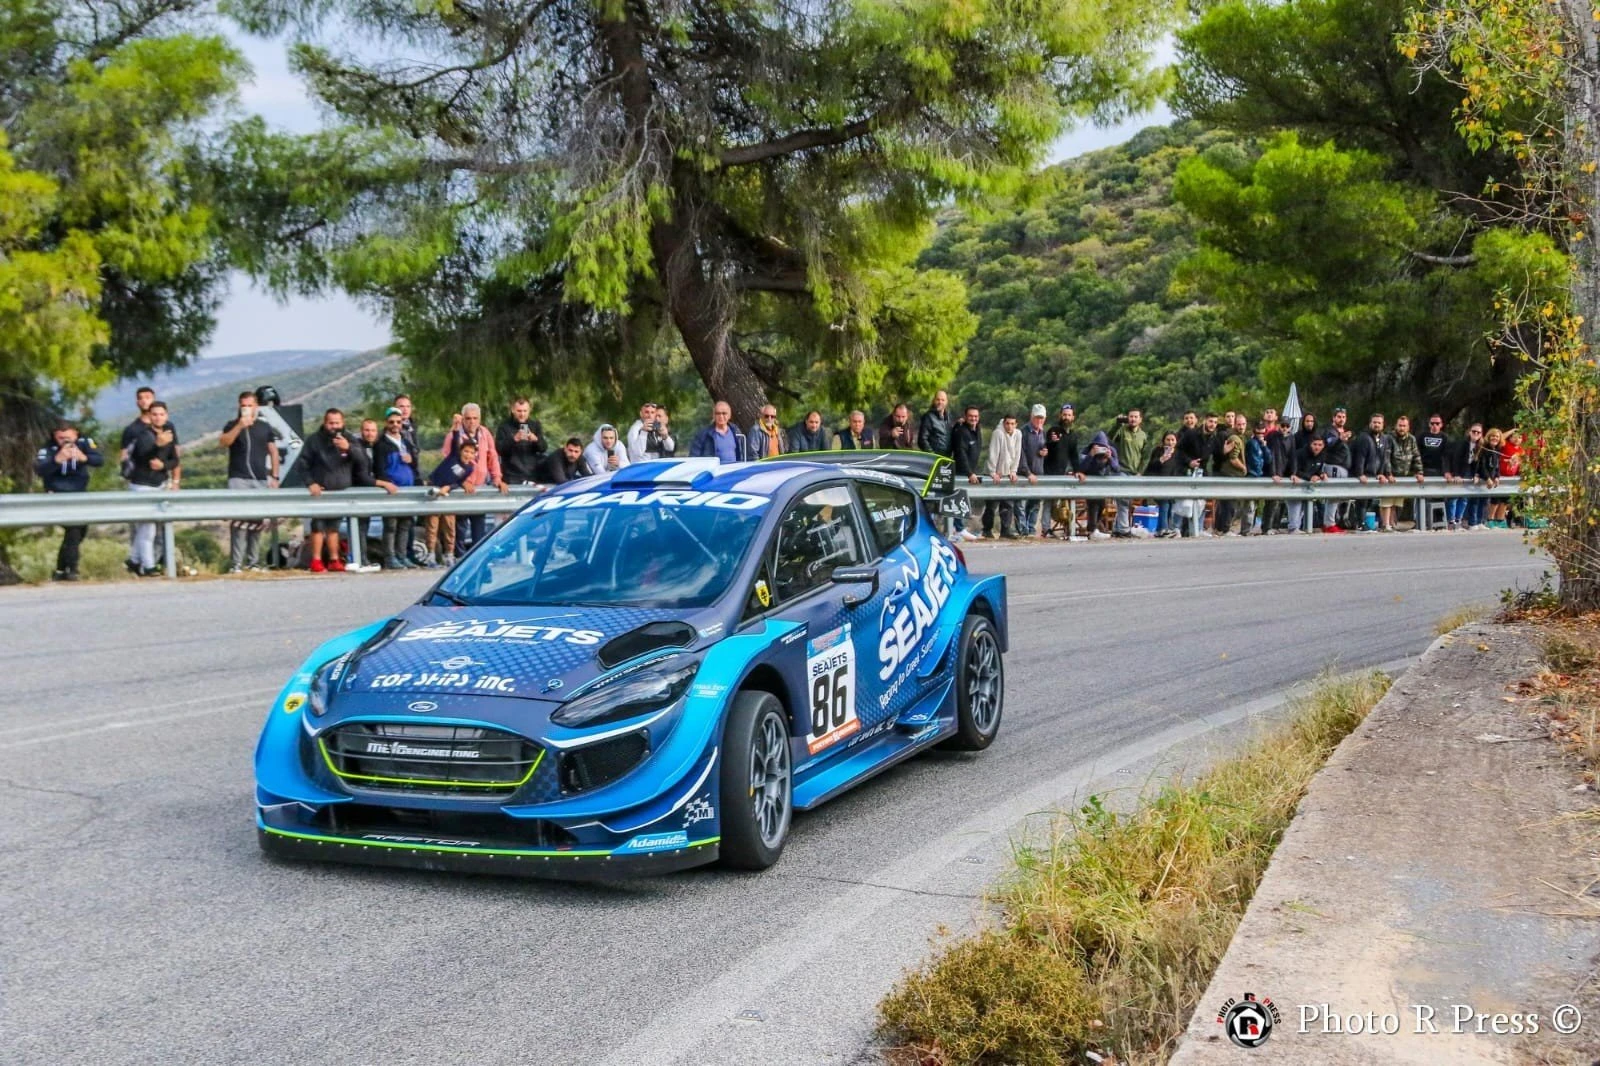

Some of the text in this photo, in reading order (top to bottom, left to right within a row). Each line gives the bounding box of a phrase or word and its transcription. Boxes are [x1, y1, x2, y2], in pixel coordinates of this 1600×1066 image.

[519, 490, 771, 514] MARIO
[879, 536, 957, 681] SEAJETS
[398, 625, 605, 645] SEAJETS
[812, 652, 848, 677] SEAJETS
[812, 664, 848, 738] 86
[362, 834, 480, 847] RAPTOR
